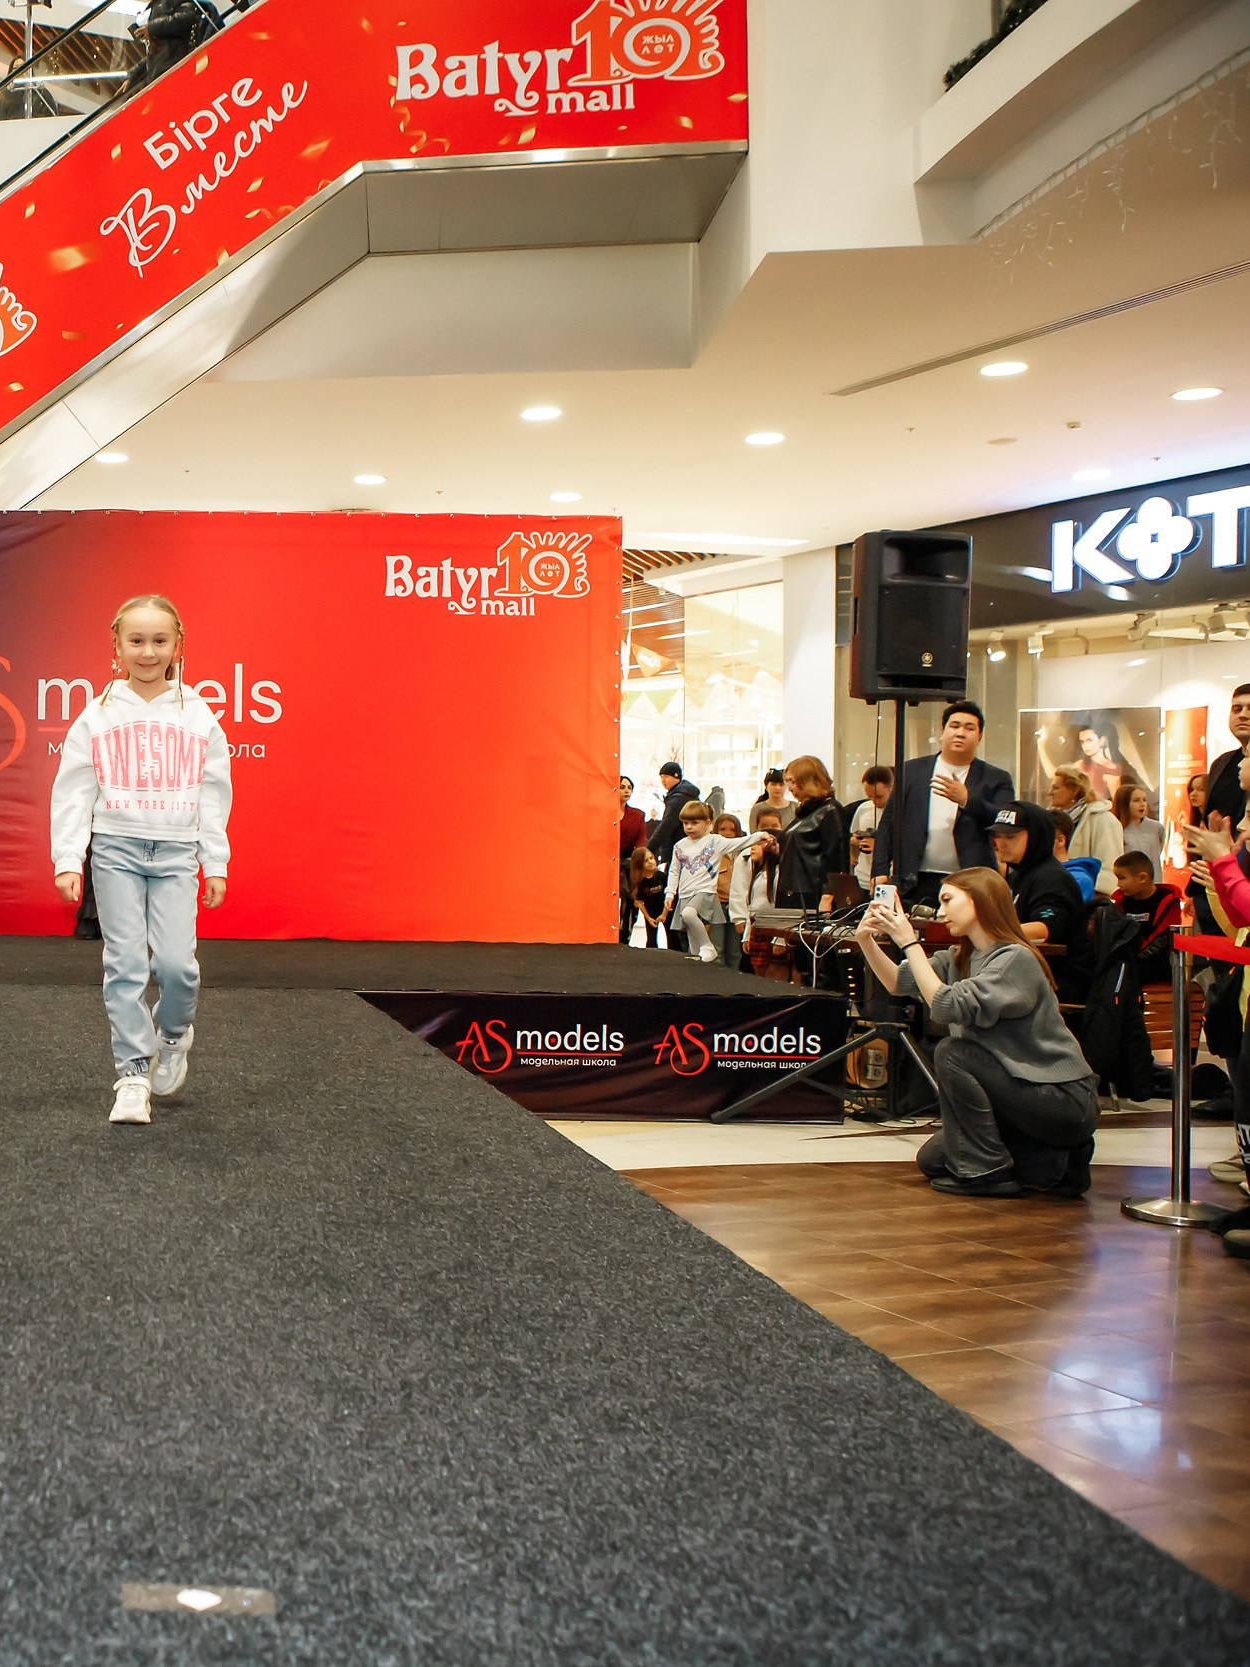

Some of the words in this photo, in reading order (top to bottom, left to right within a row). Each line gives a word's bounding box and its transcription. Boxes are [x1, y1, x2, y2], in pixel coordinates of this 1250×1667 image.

[395, 40, 574, 117] Batyr
[546, 82, 635, 115] mall
[143, 77, 263, 171] Бірге
[99, 79, 309, 279] Вместе
[385, 555, 499, 616] Batyr
[481, 597, 535, 616] mall
[37, 663, 283, 724] mels
[91, 720, 210, 792] AWESOME
[105, 800, 130, 810] NEW
[137, 800, 165, 810] YORK
[455, 1019, 512, 1074] AS
[516, 1024, 624, 1052] models
[520, 1057, 580, 1068] модельная
[582, 1058, 617, 1067] школа
[653, 1023, 710, 1076] AS
[713, 1026, 822, 1054] models
[717, 1060, 777, 1070] модельная
[779, 1061, 808, 1070] школ
